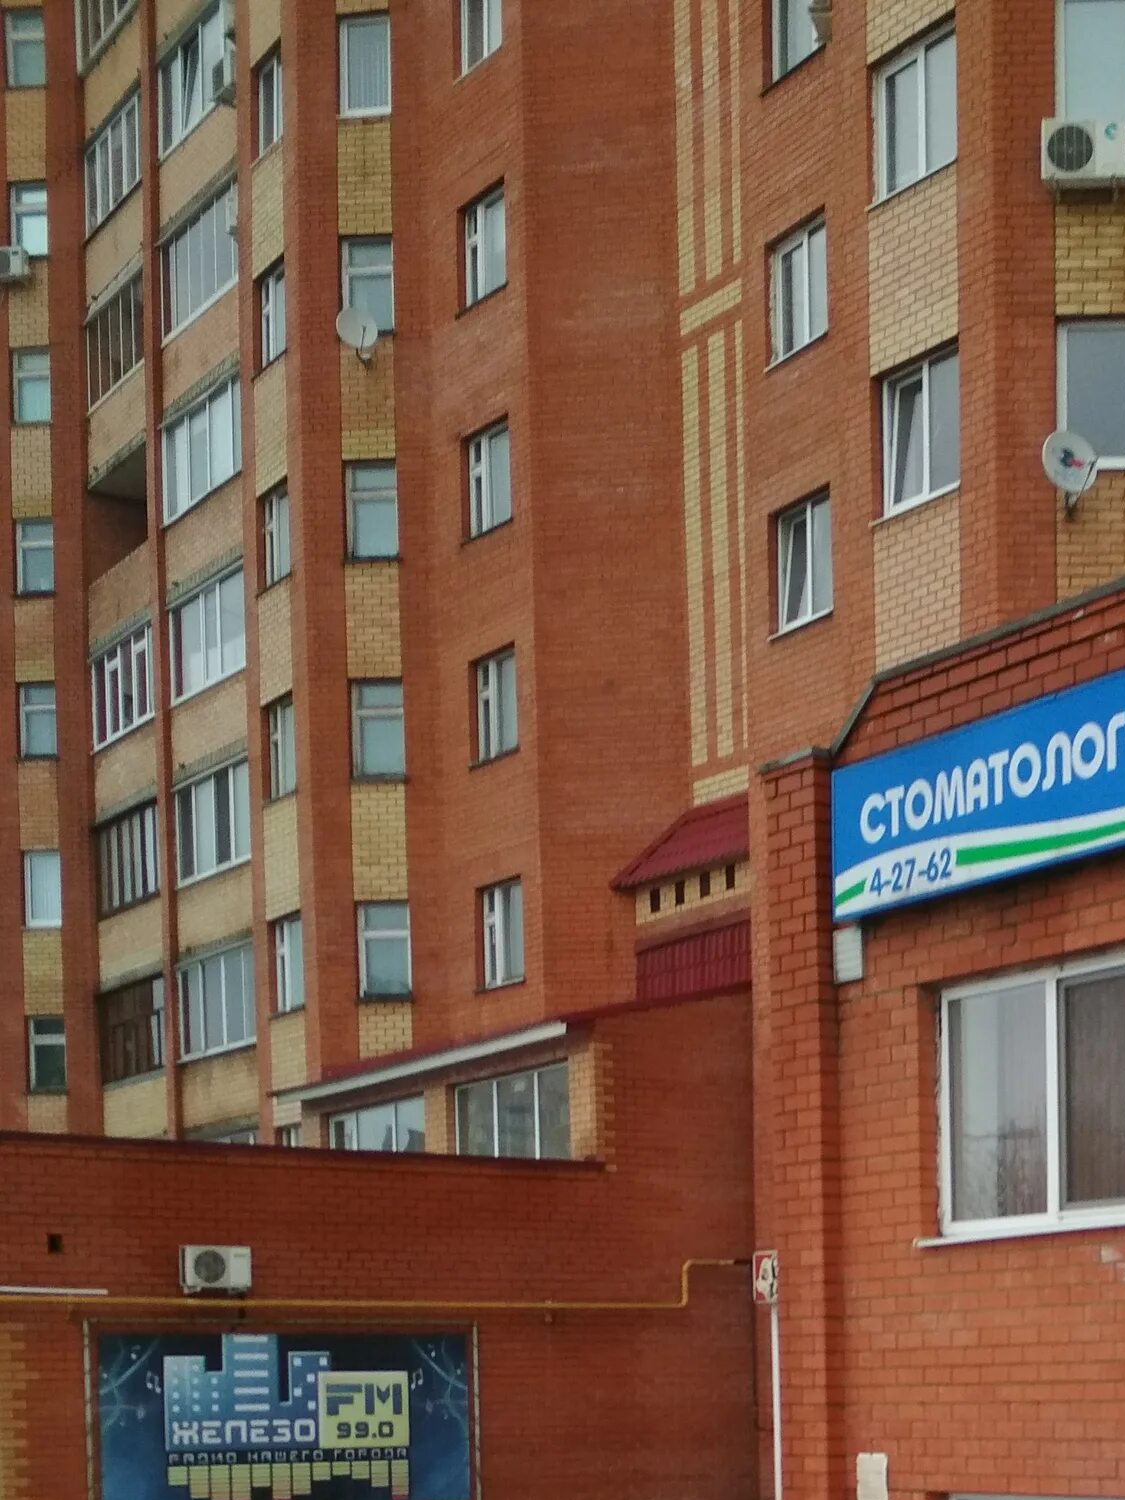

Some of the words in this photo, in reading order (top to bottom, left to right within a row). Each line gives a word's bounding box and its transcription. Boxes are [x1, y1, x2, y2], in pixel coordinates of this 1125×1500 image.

[869, 849, 953, 896] 4-27-62
[325, 1383, 403, 1416] FM
[171, 1418, 317, 1445] ЖЕЛЕЗО
[336, 1421, 395, 1440] 99.0
[167, 1451, 239, 1465] РАДИО
[247, 1448, 325, 1463] НАШЕГО
[332, 1447, 408, 1461] ГОРОДА
